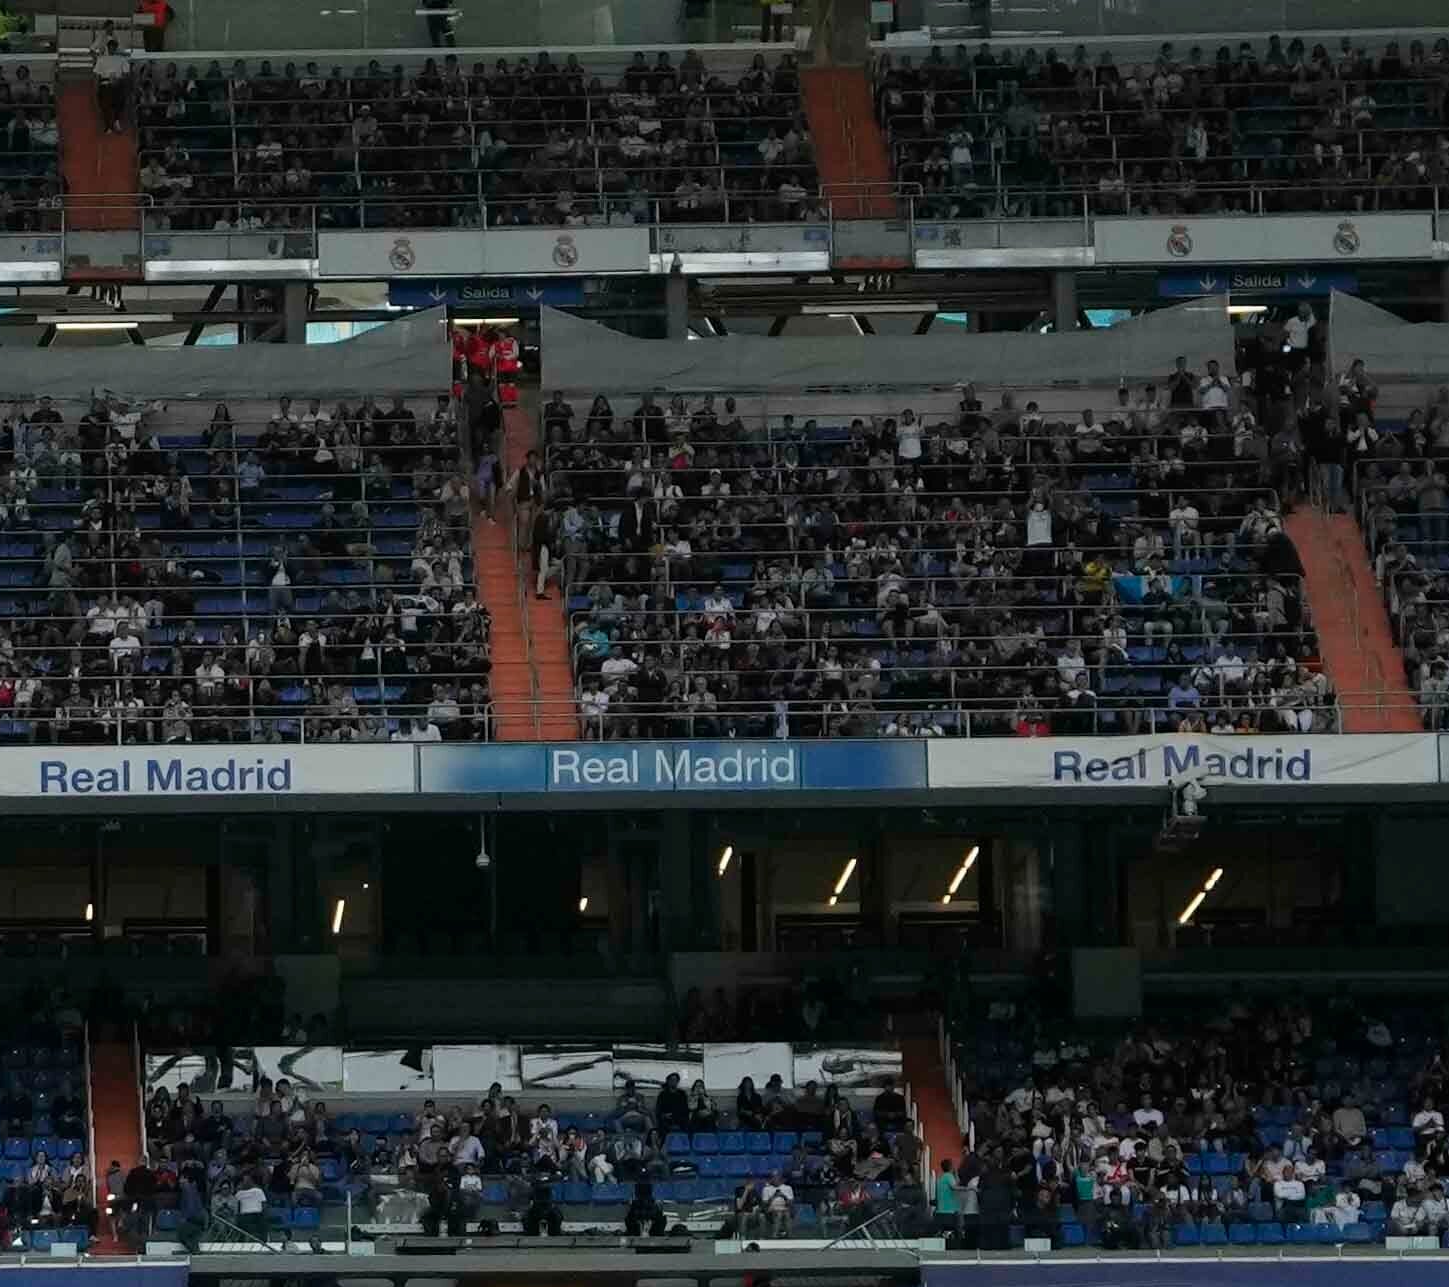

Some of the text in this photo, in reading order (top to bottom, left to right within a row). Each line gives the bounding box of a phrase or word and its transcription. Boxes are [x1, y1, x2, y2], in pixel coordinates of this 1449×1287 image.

[462, 286, 510, 299] Salida
[1233, 274, 1281, 288] Salida
[40, 758, 291, 793] Real Madrid
[554, 749, 794, 783] Real Madrid
[1055, 750, 1146, 783] Real
